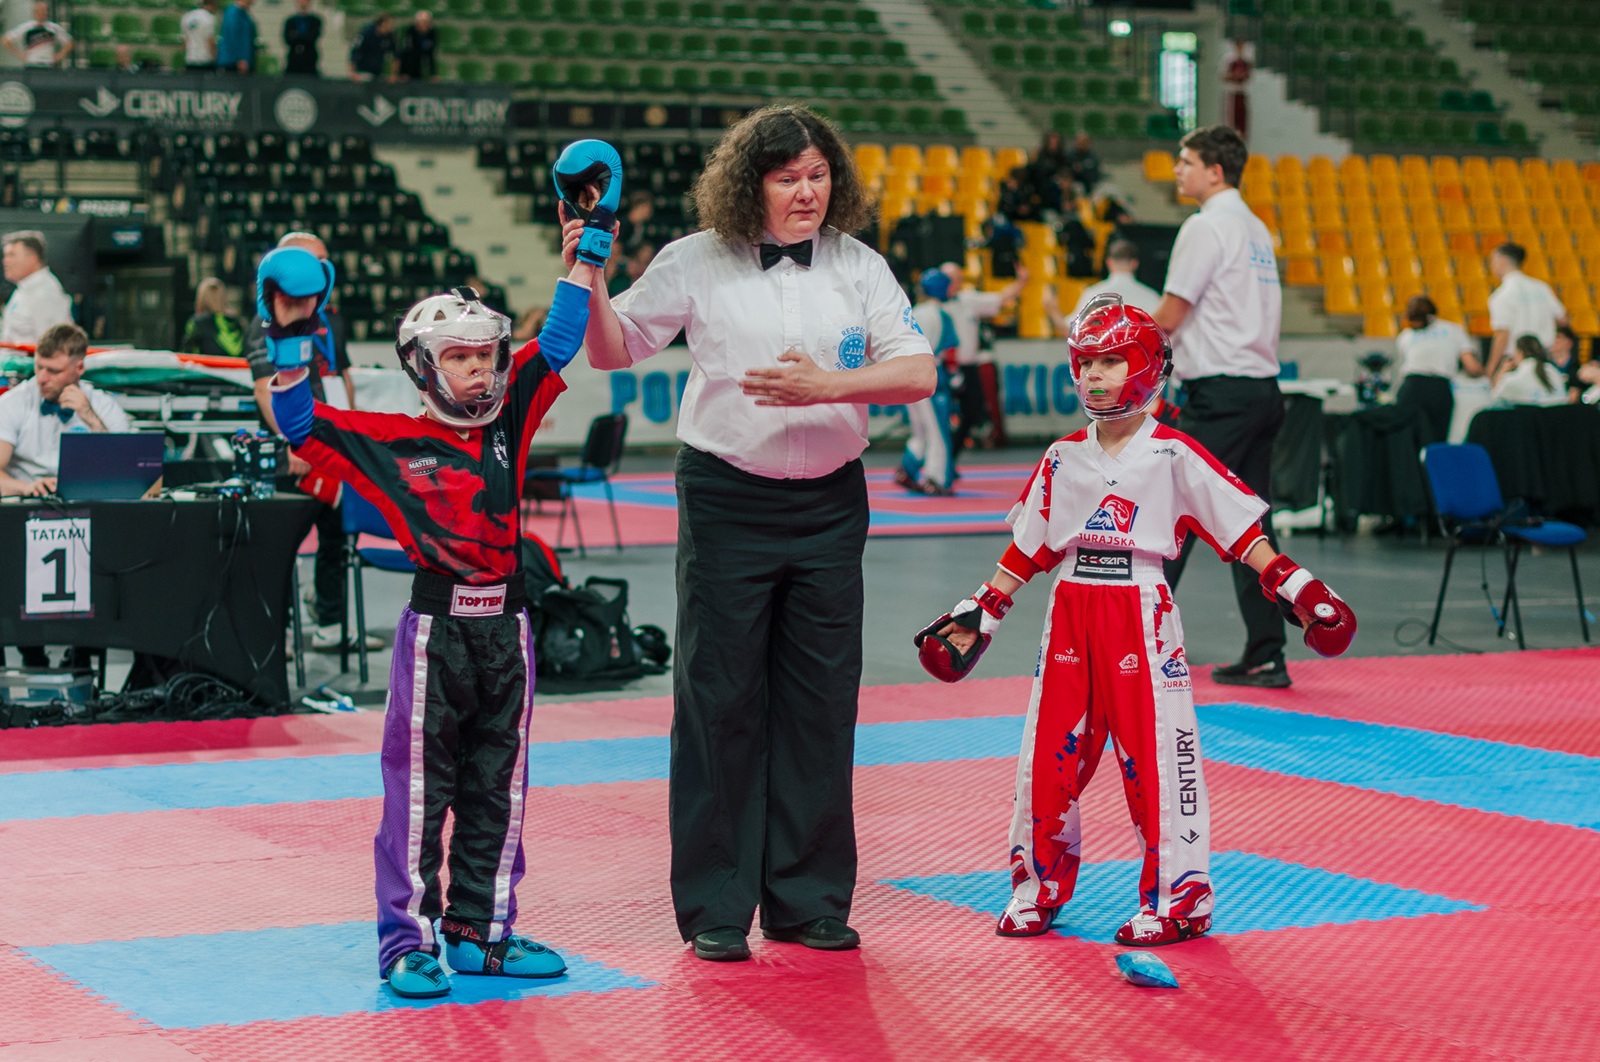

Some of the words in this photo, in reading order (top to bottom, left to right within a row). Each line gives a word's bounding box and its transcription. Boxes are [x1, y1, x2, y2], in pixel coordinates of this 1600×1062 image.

[124, 88, 243, 119] CENTURY
[399, 96, 510, 125] CENTURY
[408, 458, 437, 469] MASTERS
[30, 528, 85, 540] TATAMI
[1078, 533, 1136, 546] JURAJSKA
[41, 547, 76, 602] 1
